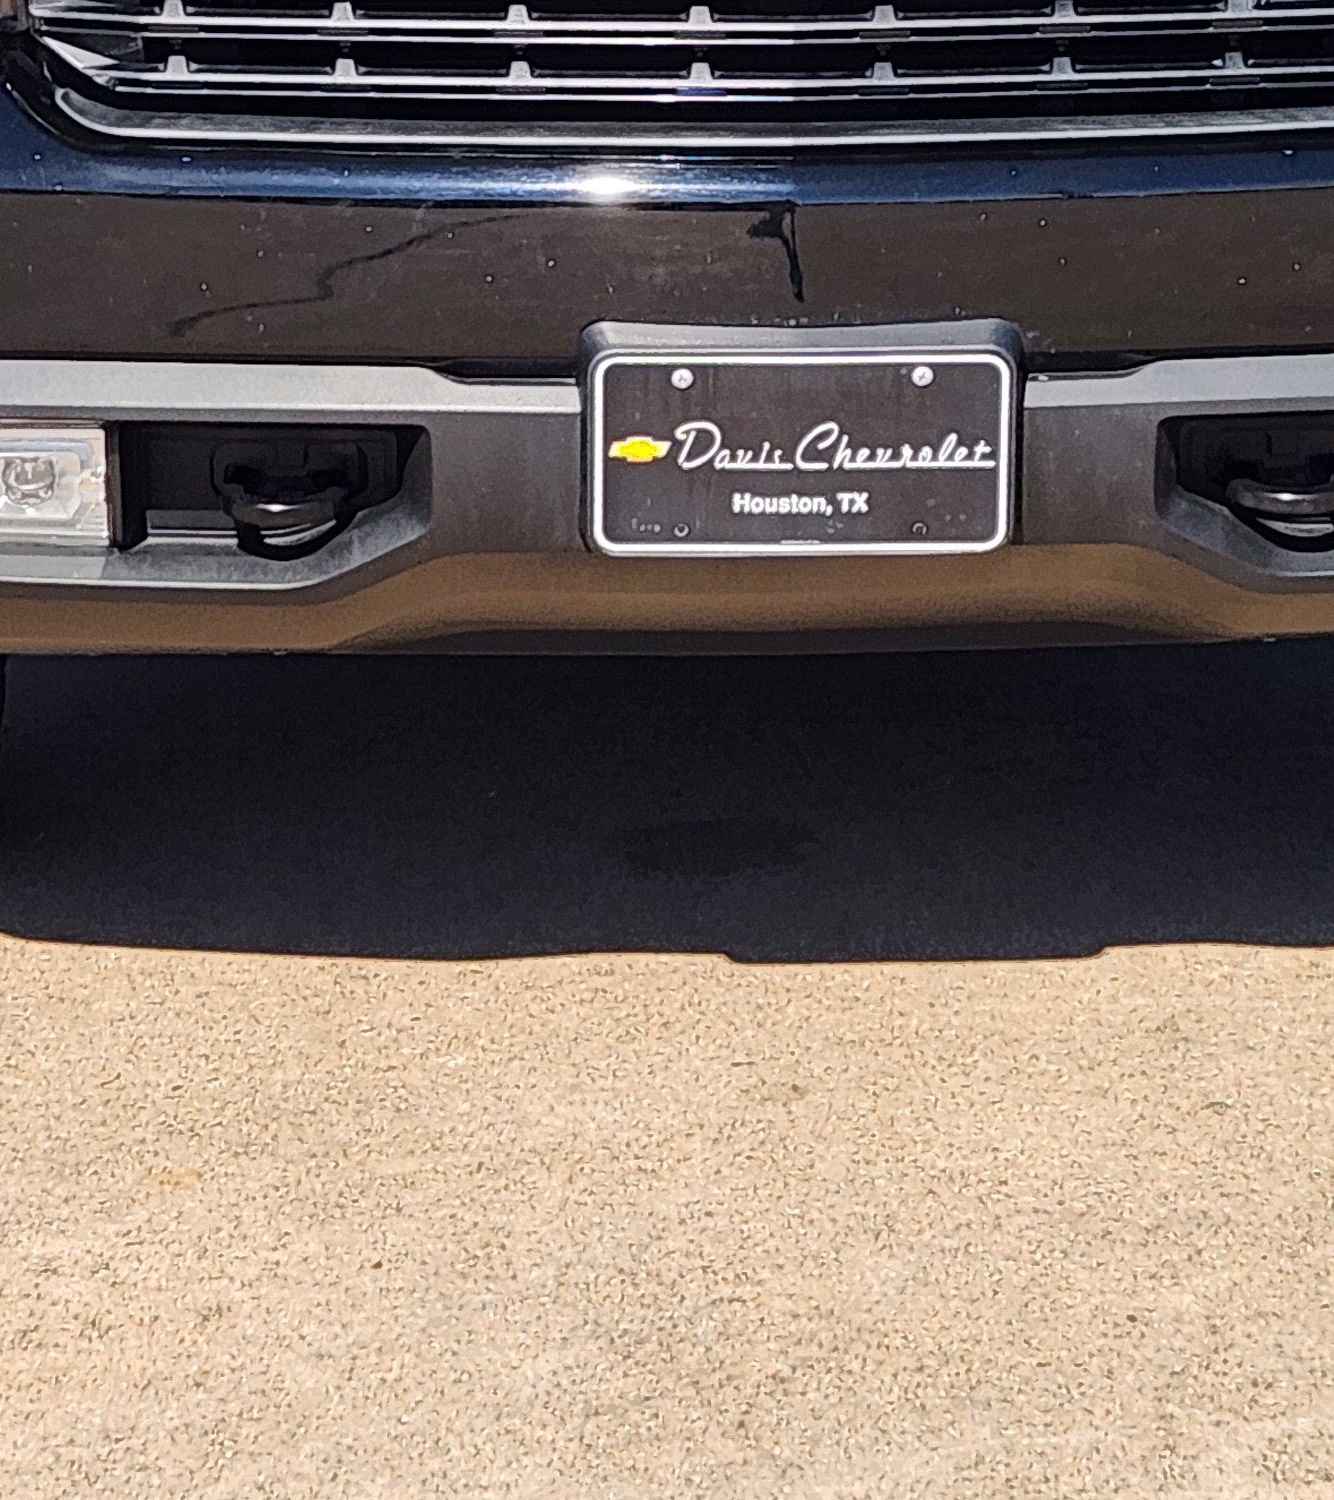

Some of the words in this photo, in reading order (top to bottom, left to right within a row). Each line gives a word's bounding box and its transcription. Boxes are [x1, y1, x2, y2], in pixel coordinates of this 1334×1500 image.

[673, 420, 795, 471] Davis
[795, 420, 997, 472] Chevrolet
[731, 492, 833, 517] Houston,
[836, 491, 870, 515] TX
